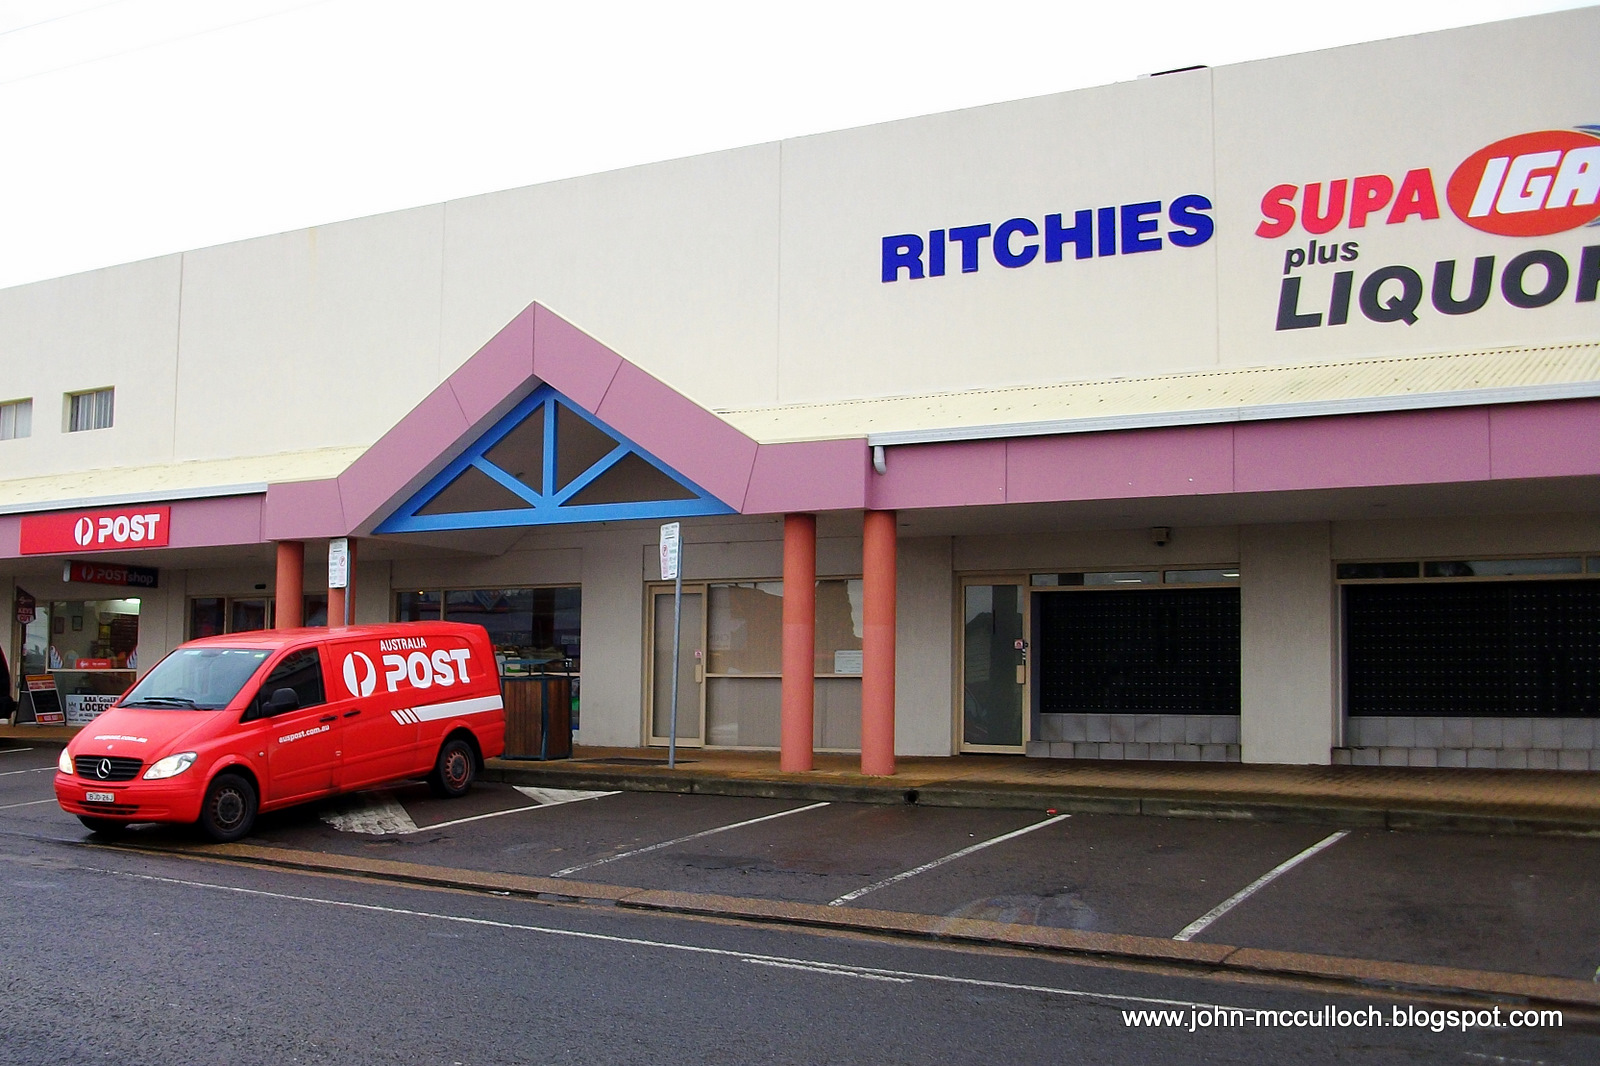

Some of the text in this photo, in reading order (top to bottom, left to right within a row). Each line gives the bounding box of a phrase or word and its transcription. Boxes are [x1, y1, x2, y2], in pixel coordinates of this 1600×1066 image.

[1255, 145, 1600, 239] SUPA IGA
[881, 194, 1214, 283] RITCHIES
[1283, 240, 1359, 275] plus
[98, 514, 160, 543] POST
[380, 637, 427, 651] AUSTRALIA
[382, 648, 471, 692] POST
[278, 724, 330, 744] auspost.com.au
